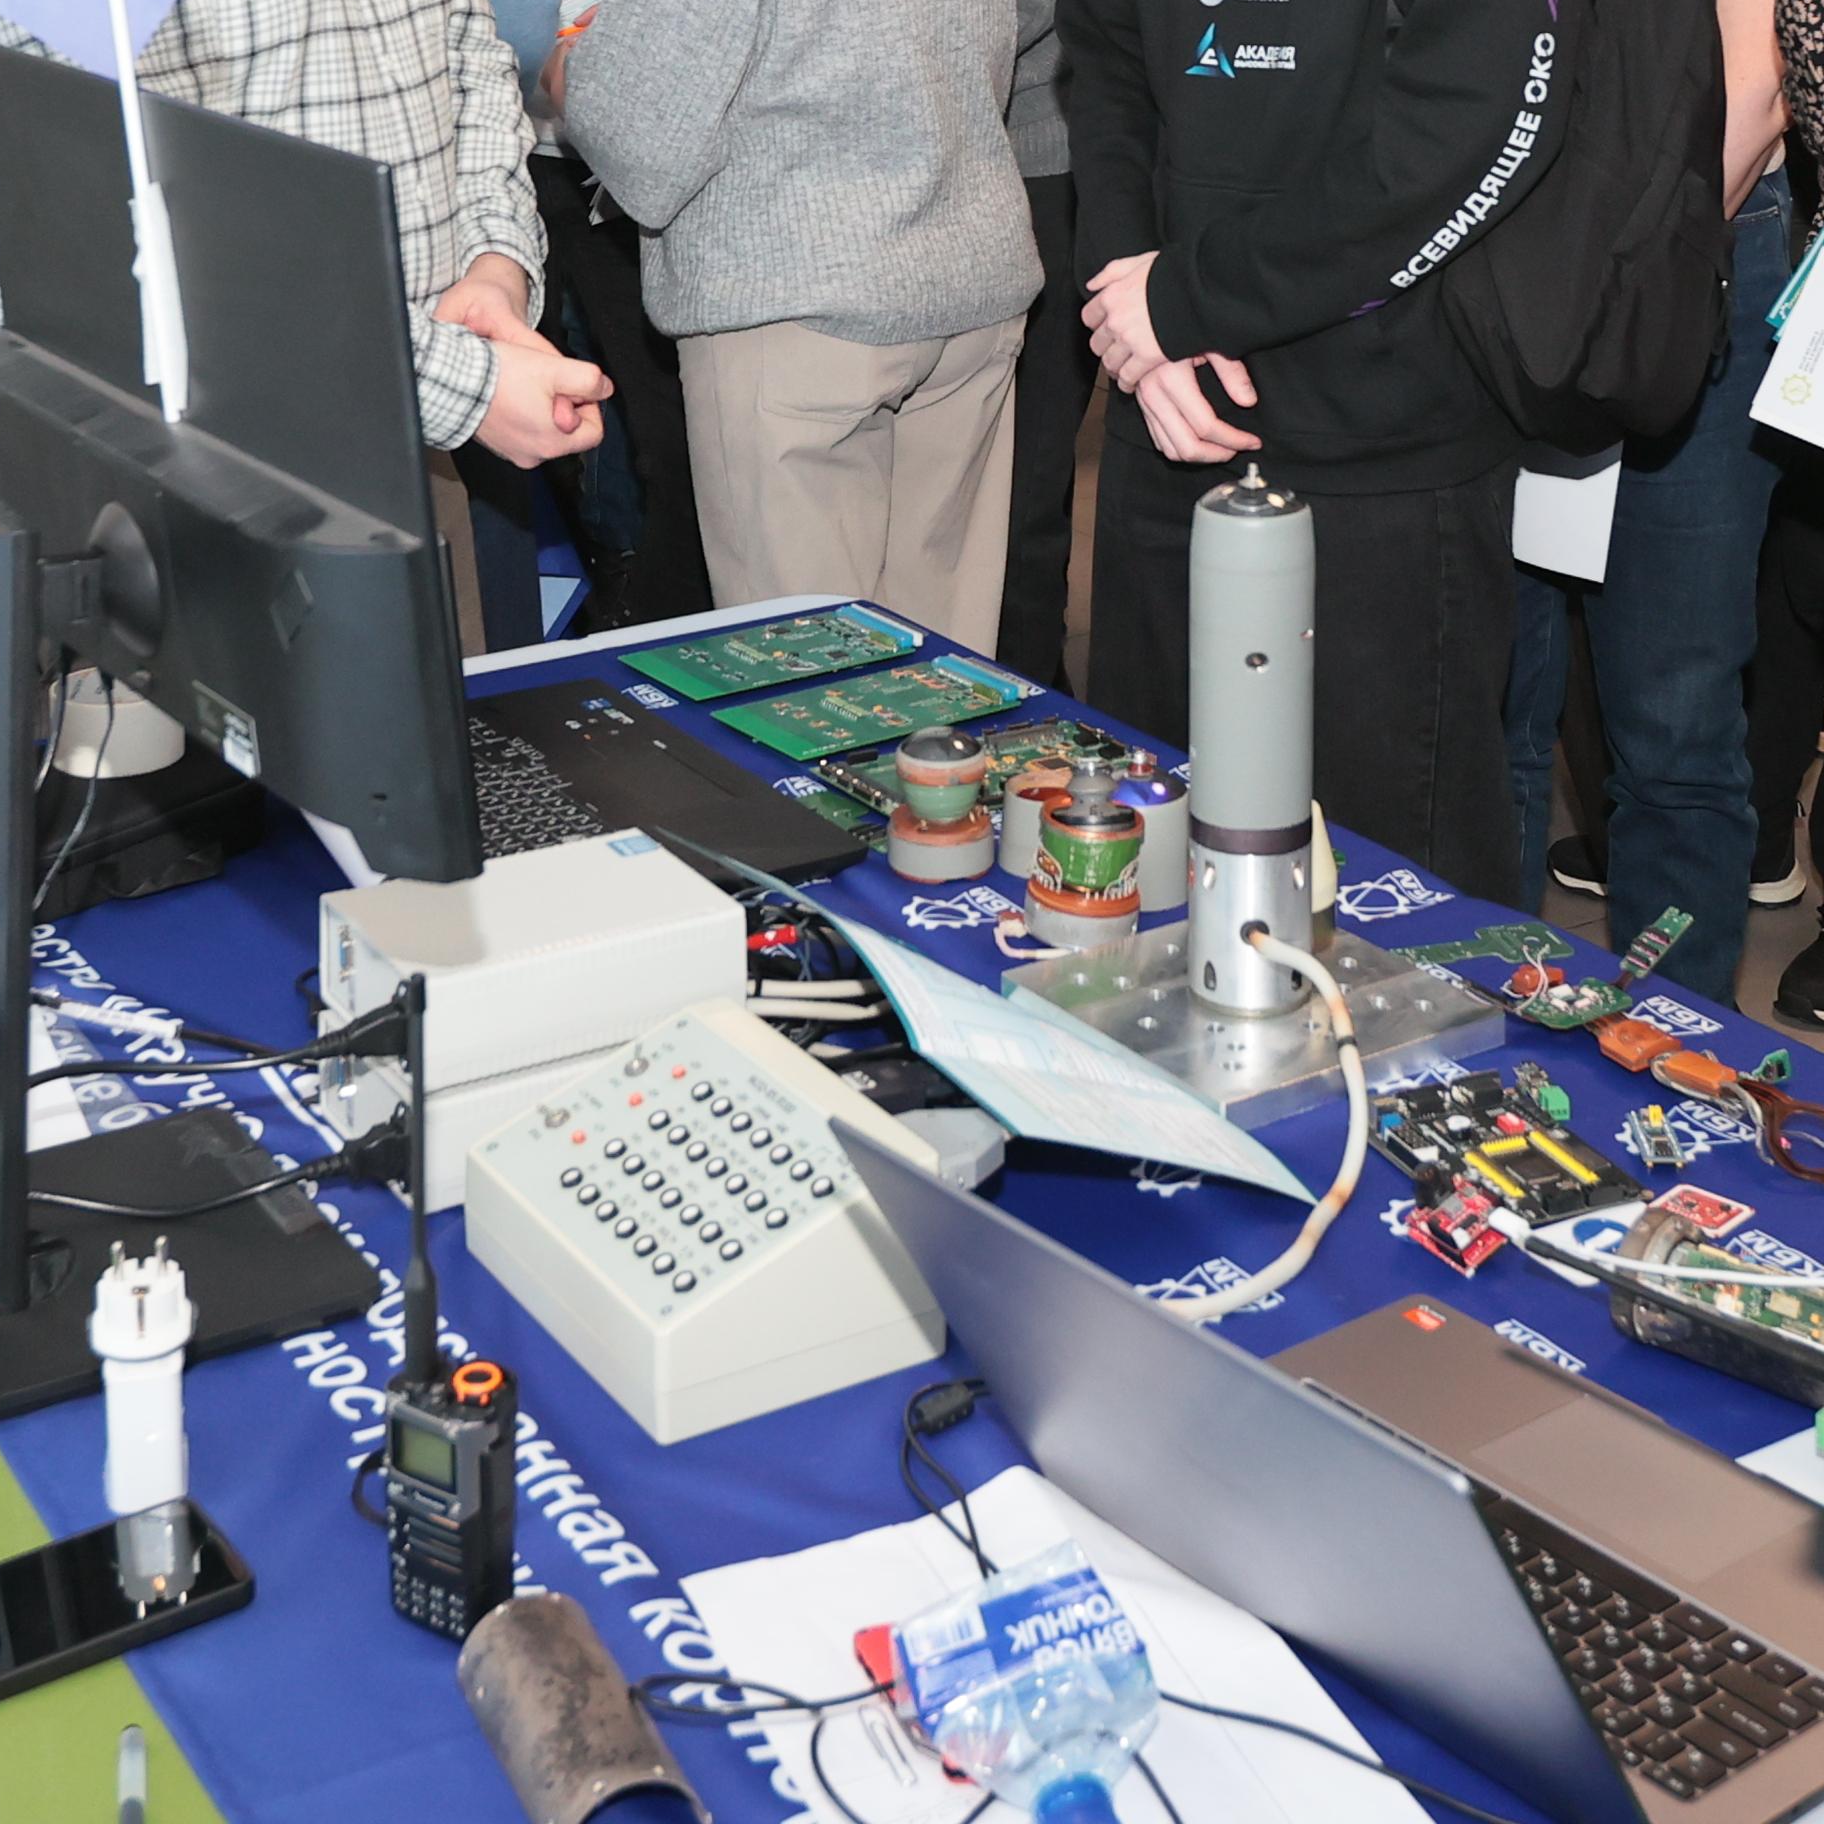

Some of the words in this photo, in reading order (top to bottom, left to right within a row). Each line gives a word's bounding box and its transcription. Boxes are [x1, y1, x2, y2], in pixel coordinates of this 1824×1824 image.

[1389, 110, 1542, 291] ВСЕВИДЯЩЕЕ
[1524, 32, 1557, 105] ОКО
[1645, 995, 1724, 1036] КБМ
